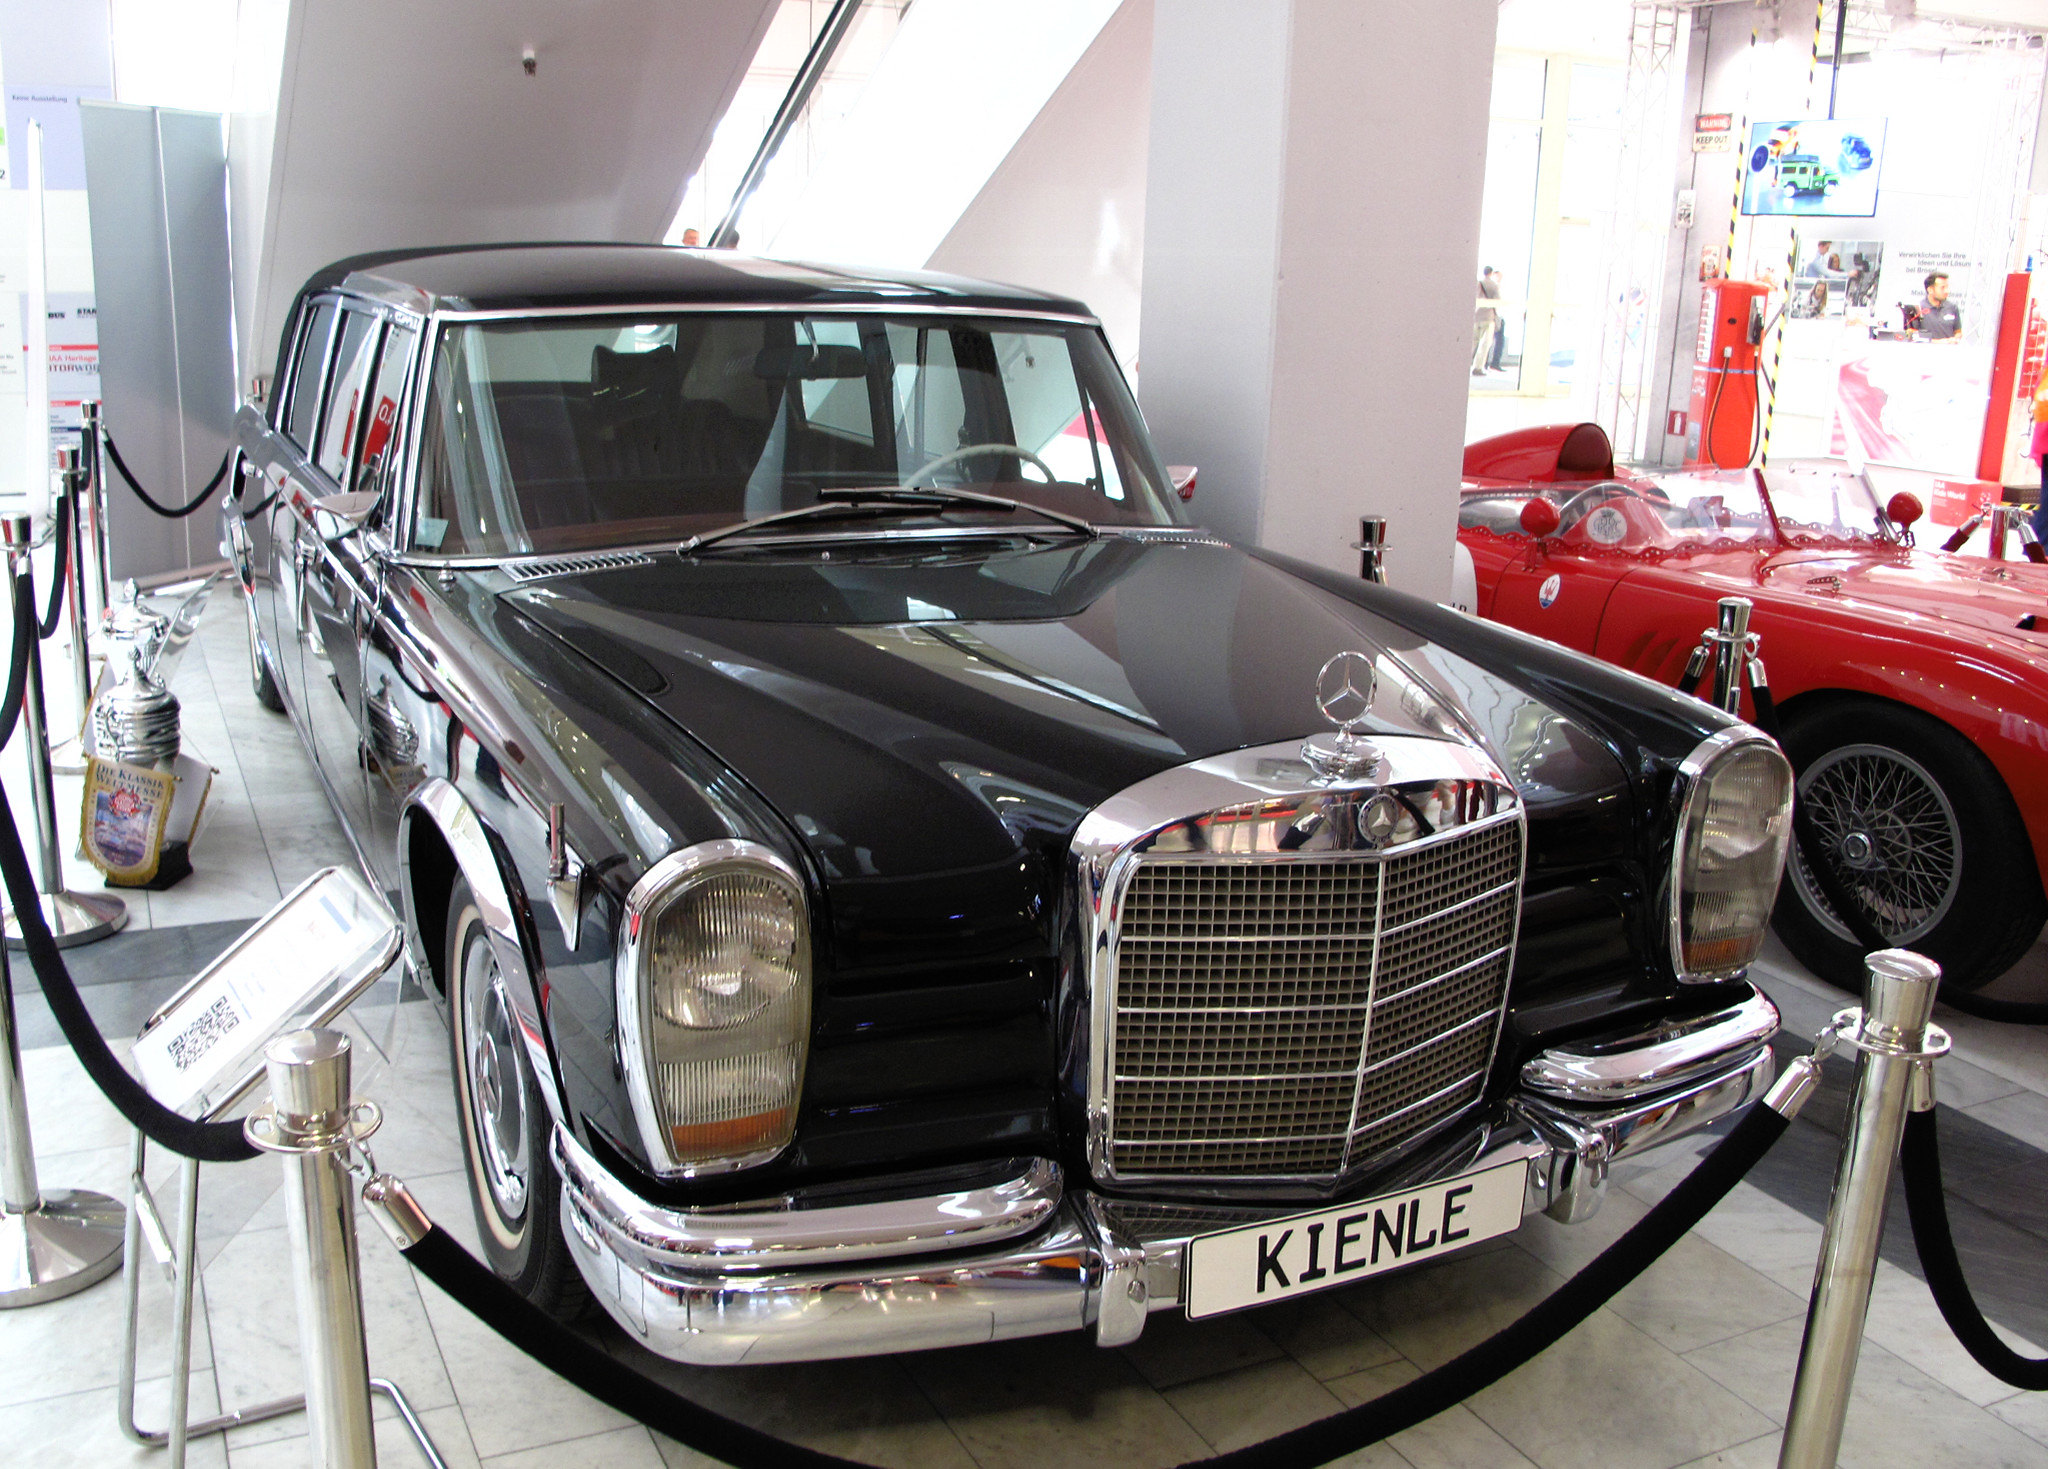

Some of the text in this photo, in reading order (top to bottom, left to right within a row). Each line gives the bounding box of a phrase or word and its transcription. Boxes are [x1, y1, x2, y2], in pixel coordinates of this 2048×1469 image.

[1696, 135, 1728, 144] KEEP OUT
[1947, 491, 1966, 500] World
[97, 764, 163, 788] DIE KLASSIK
[1256, 1184, 1473, 1294] KIENLE
